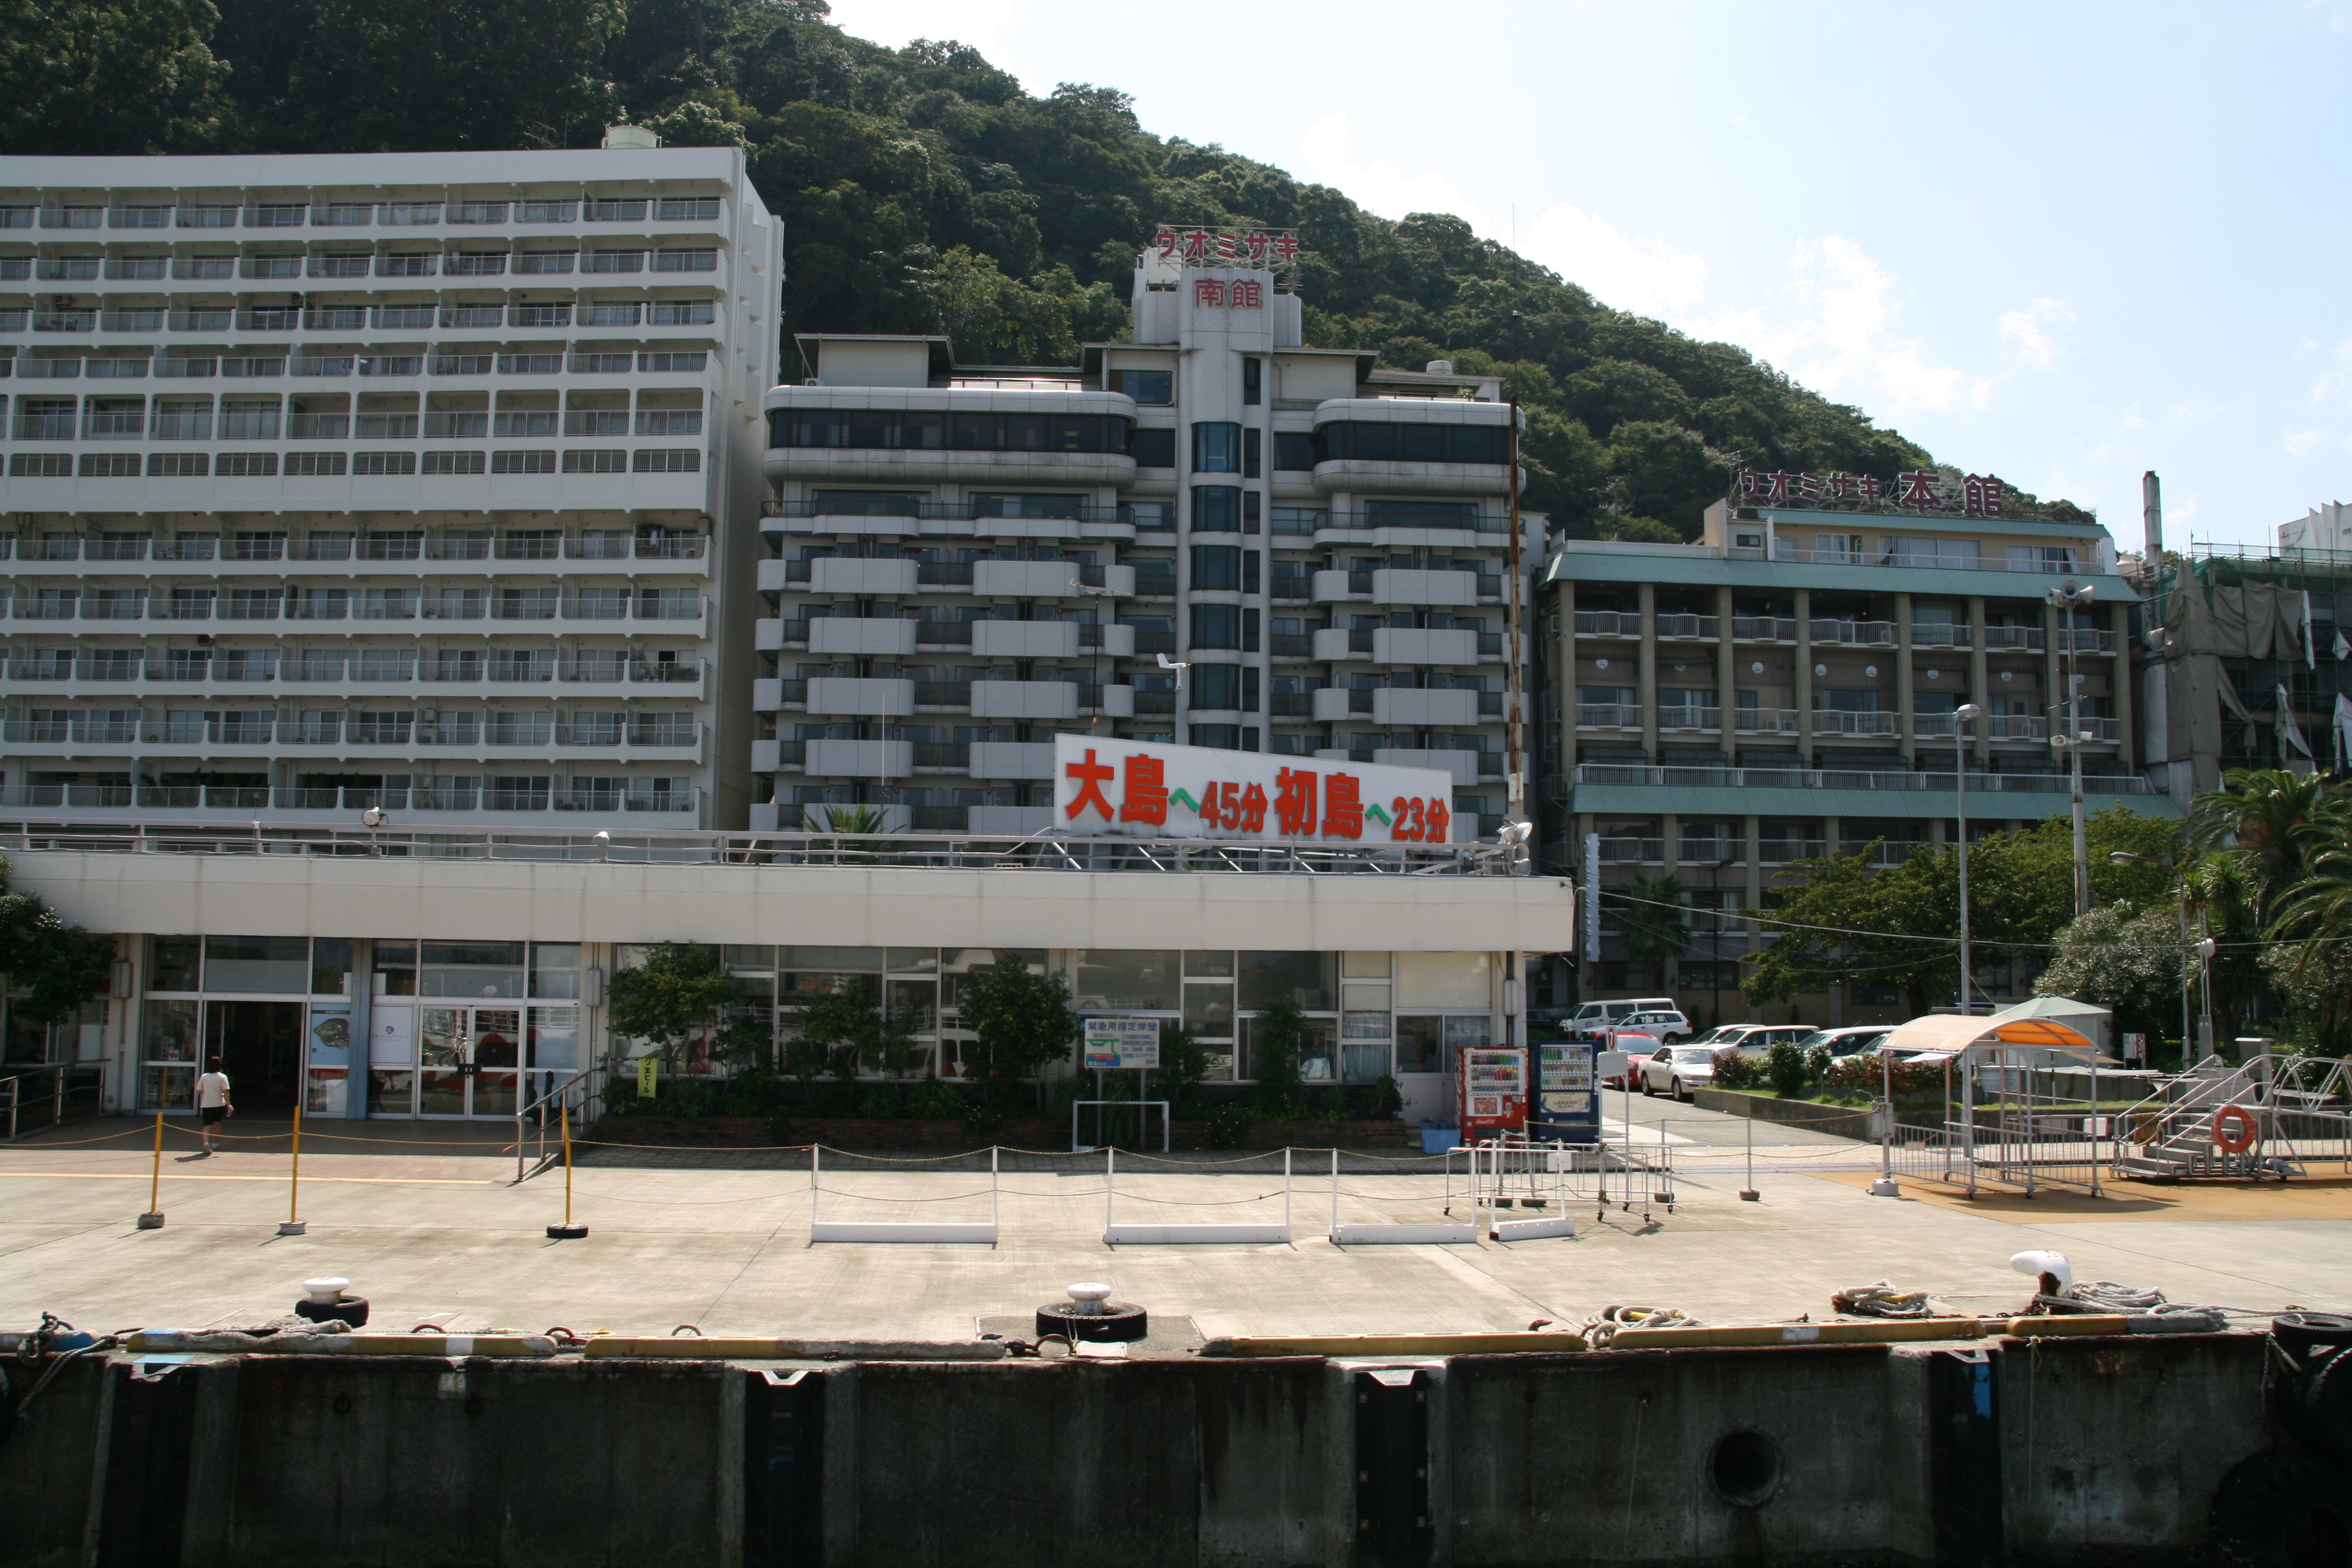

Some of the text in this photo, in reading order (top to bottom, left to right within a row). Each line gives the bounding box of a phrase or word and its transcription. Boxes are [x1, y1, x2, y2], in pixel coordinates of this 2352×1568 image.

[1155, 229, 1299, 263] ウオミサキ
[1195, 277, 1262, 308] 南館
[1088, 1021, 1157, 1032] 緊急用指定岸壁
[1609, 1031, 1614, 1048] 7
